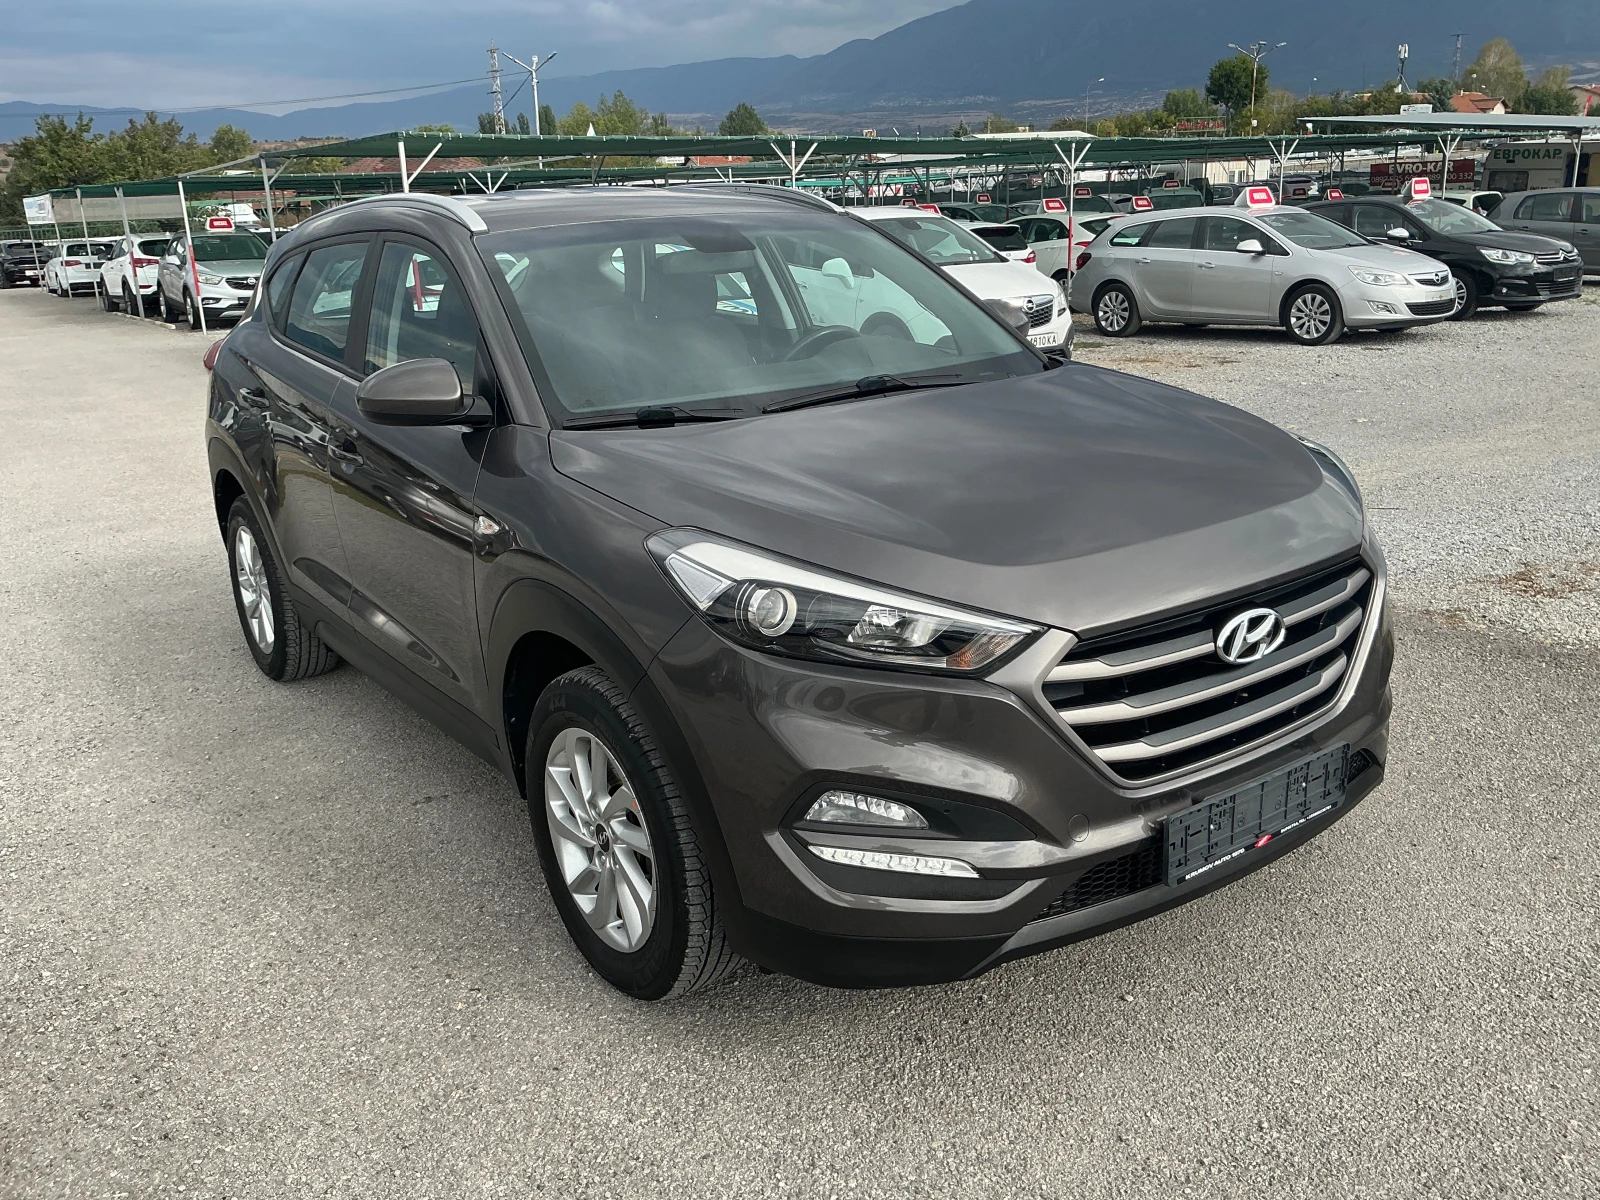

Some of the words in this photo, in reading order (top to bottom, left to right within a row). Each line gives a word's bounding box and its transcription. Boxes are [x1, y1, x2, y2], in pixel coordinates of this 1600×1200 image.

[1493, 148, 1563, 160] ЕВРОКАР
[1458, 171, 1474, 180] 332
[1030, 334, 1057, 347] 810KA
[1185, 862, 1214, 880] KRUMOV
[1213, 854, 1231, 867] AUTO
